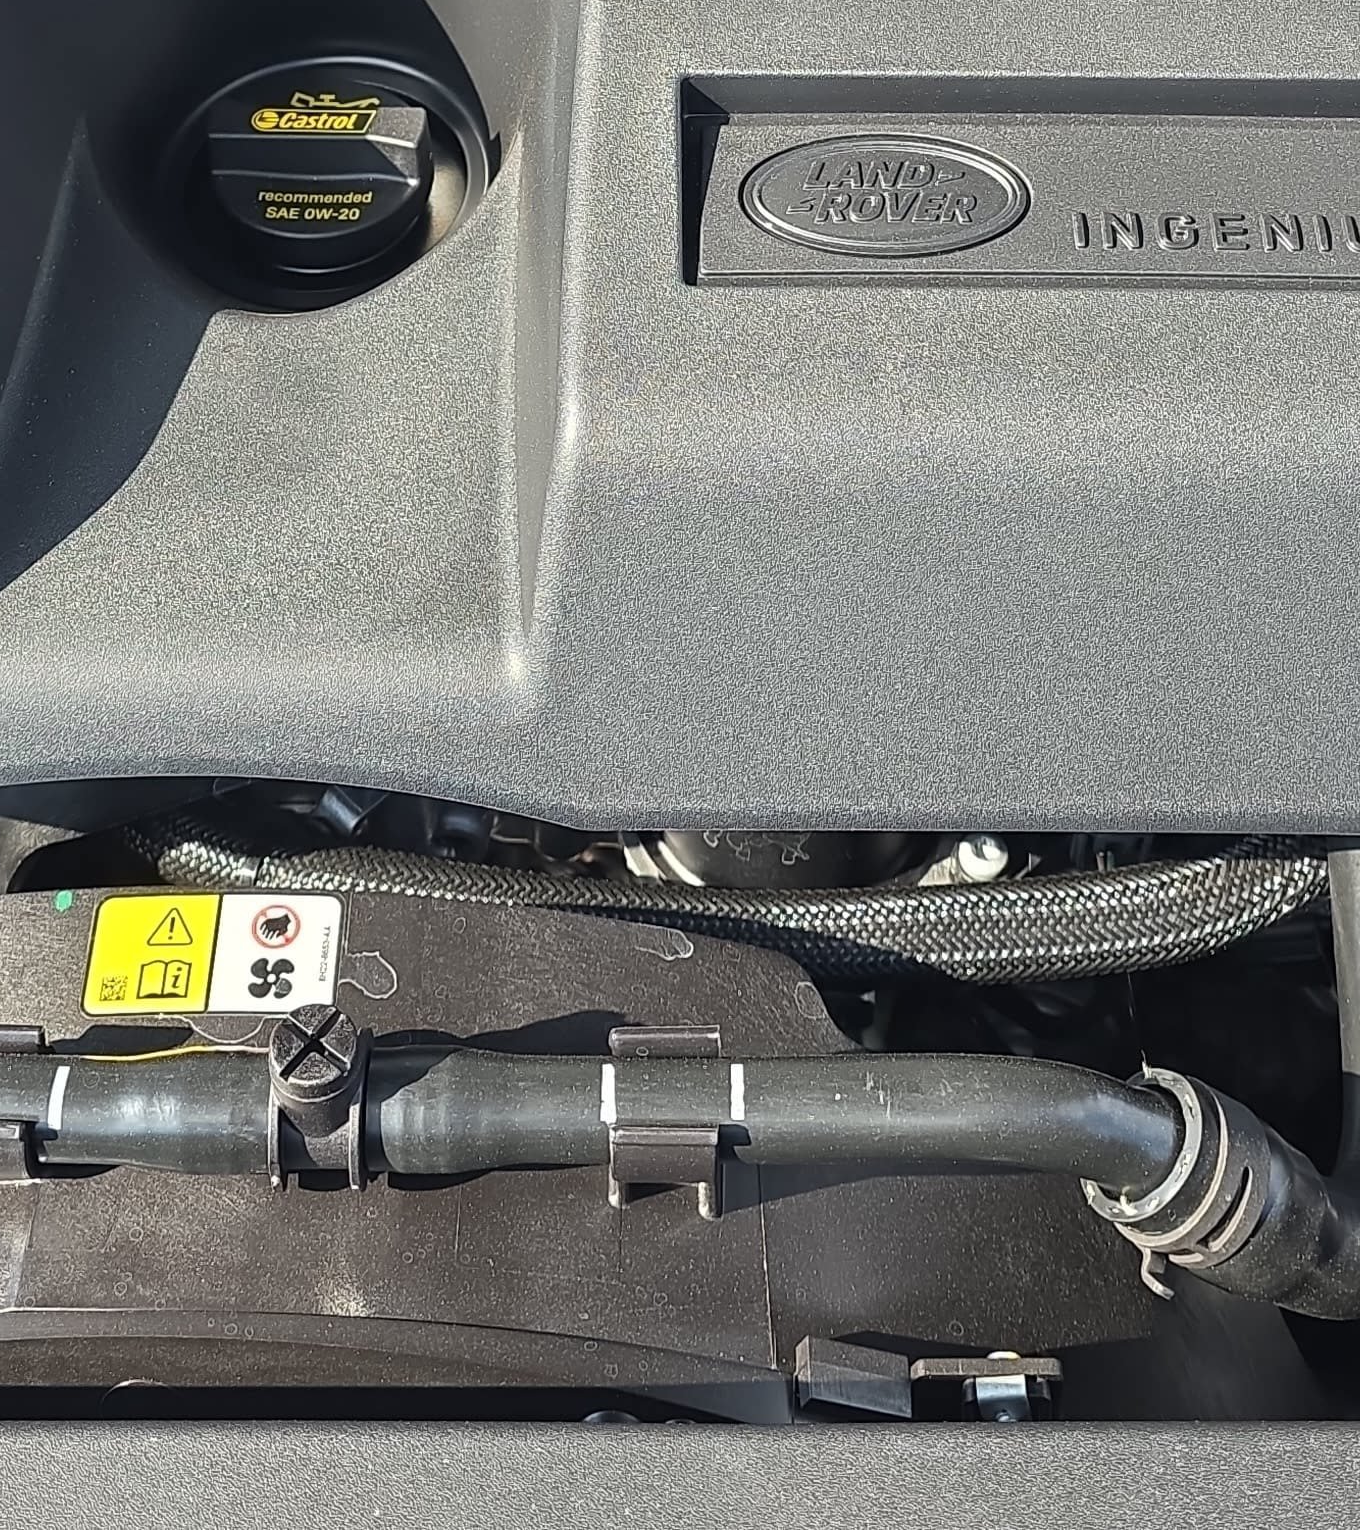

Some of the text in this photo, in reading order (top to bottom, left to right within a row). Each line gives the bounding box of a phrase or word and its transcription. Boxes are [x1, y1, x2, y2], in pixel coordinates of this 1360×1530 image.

[278, 111, 358, 131] Castrol
[803, 160, 935, 191] LAND
[257, 190, 373, 204] recommended
[265, 206, 360, 221] SAE 0W-20
[814, 191, 978, 224] ROVER
